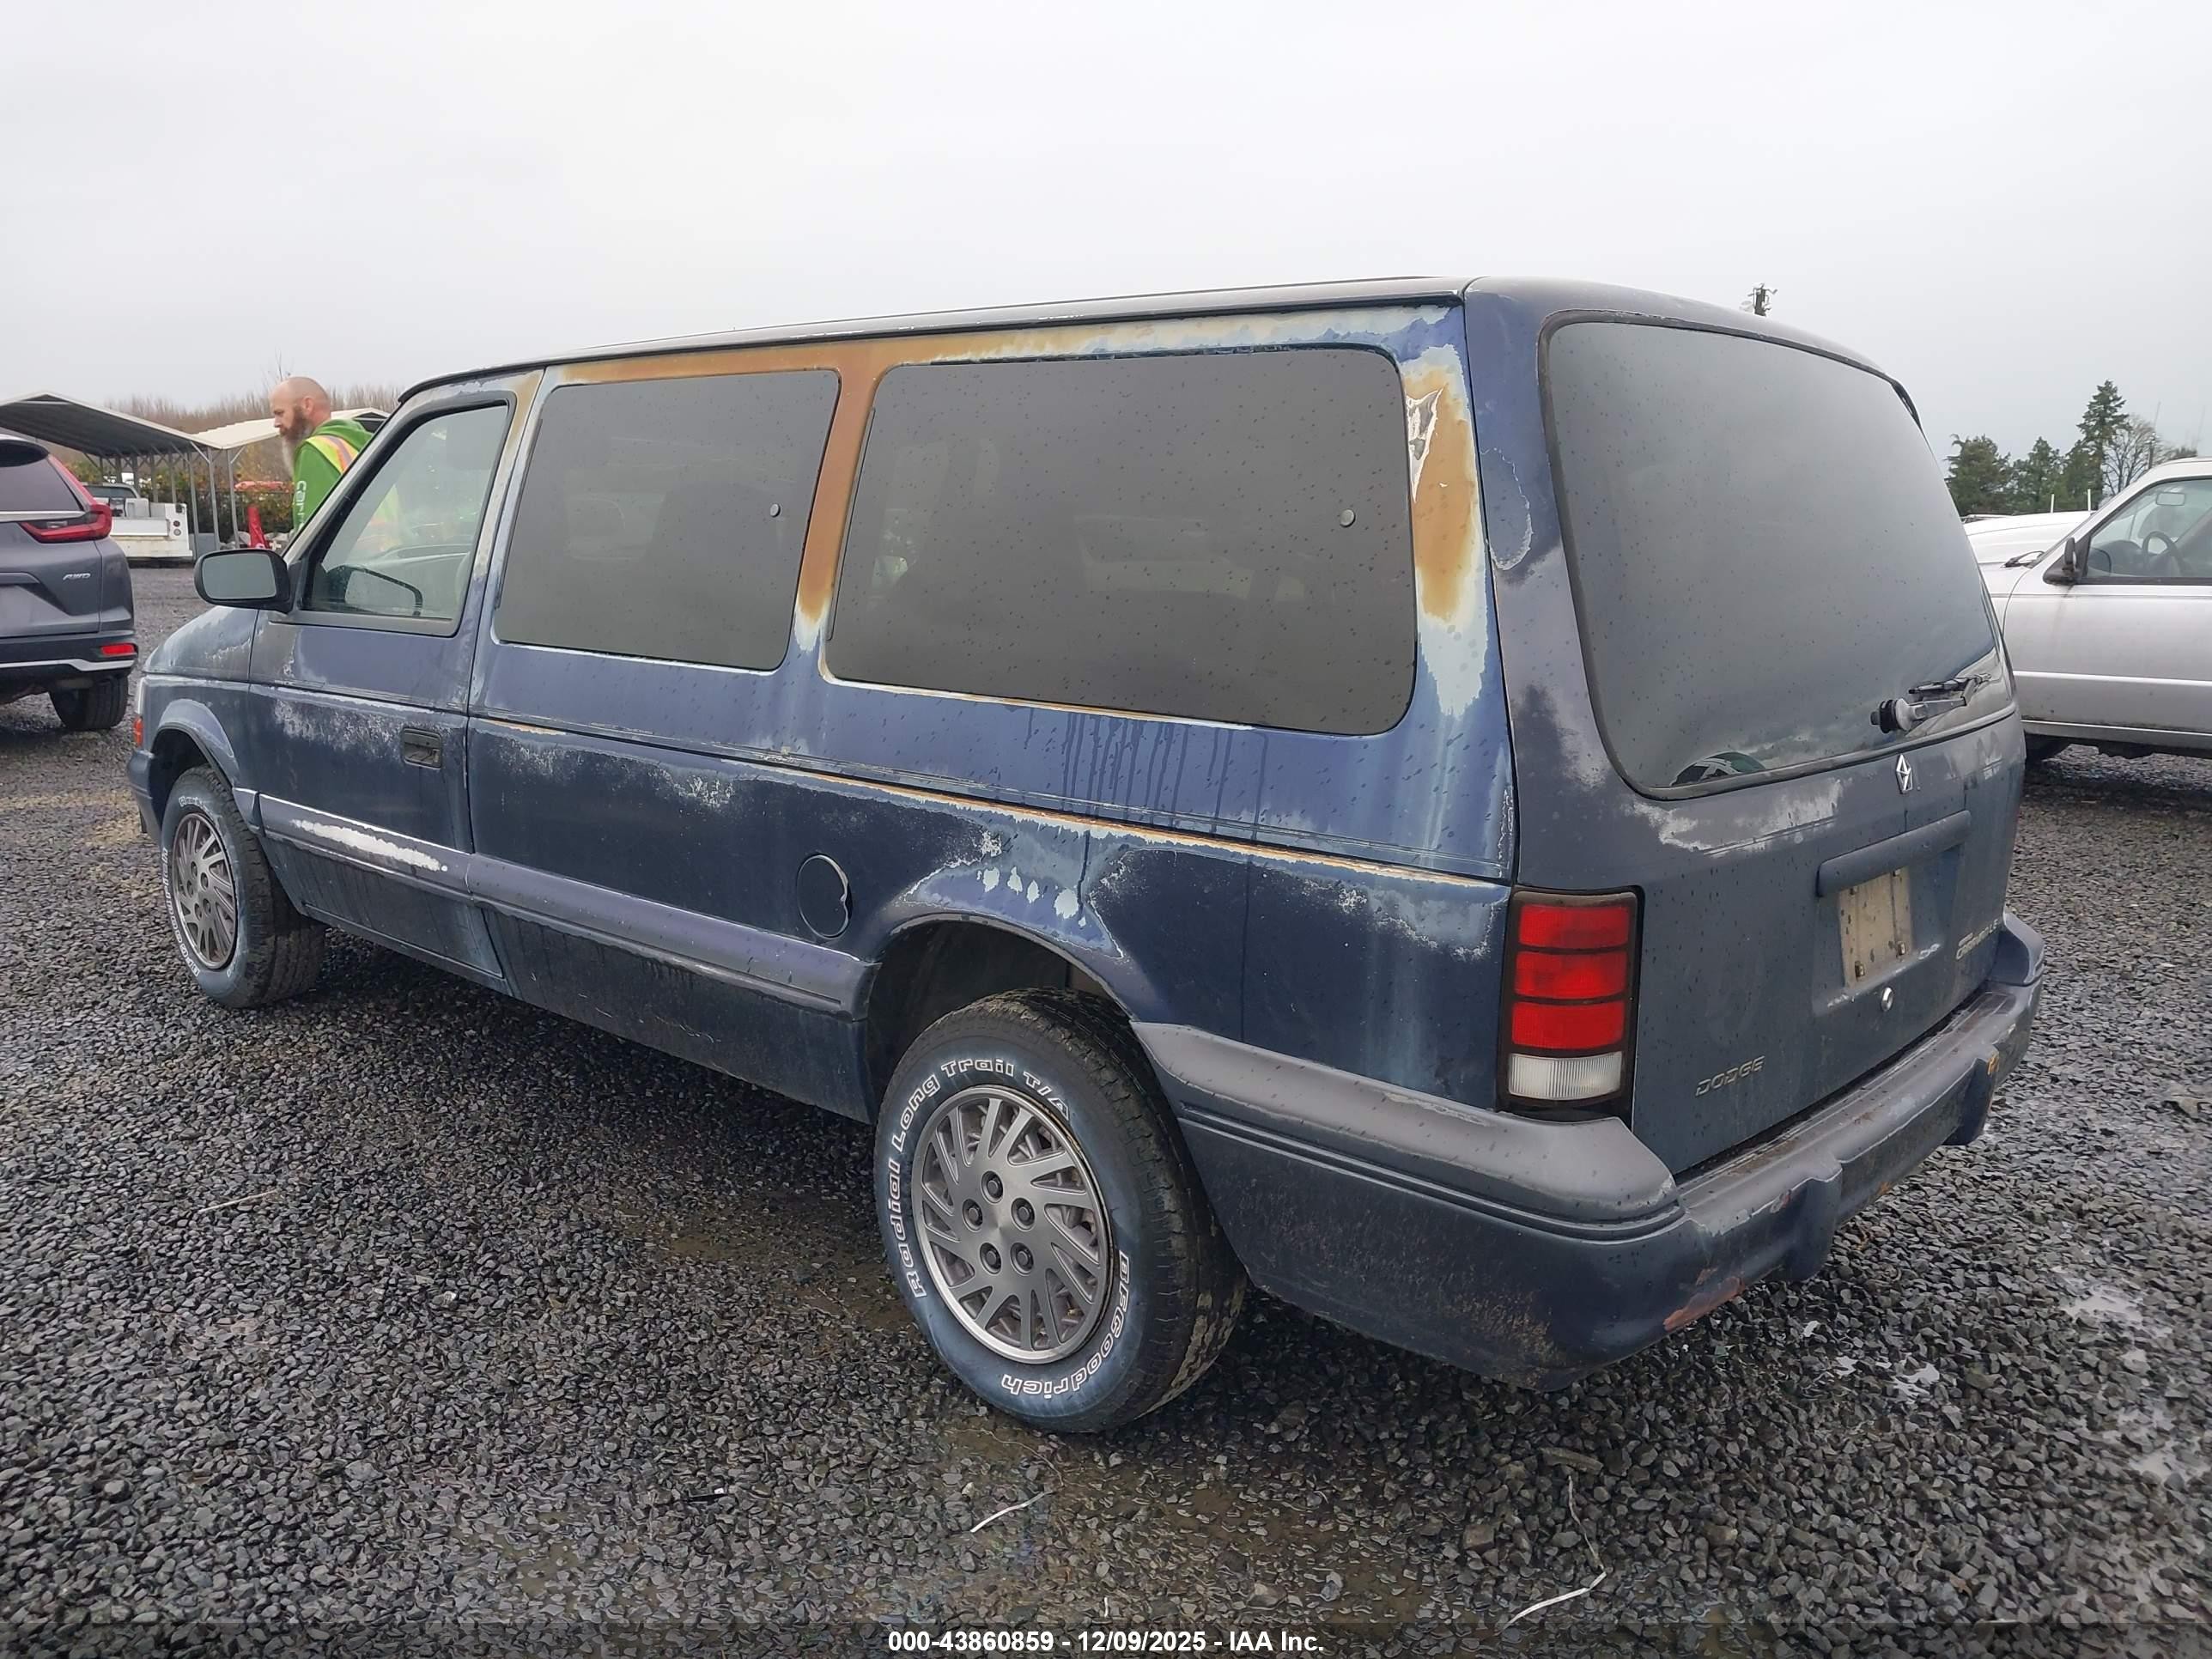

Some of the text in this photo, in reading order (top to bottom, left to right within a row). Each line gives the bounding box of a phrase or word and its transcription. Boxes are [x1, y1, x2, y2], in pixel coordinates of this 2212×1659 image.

[1695, 1055, 1765, 1097] DODGE
[888, 1059, 1071, 1298] Radial Long Trail T/A
[1001, 1249, 1130, 1399] BFGoodrich
